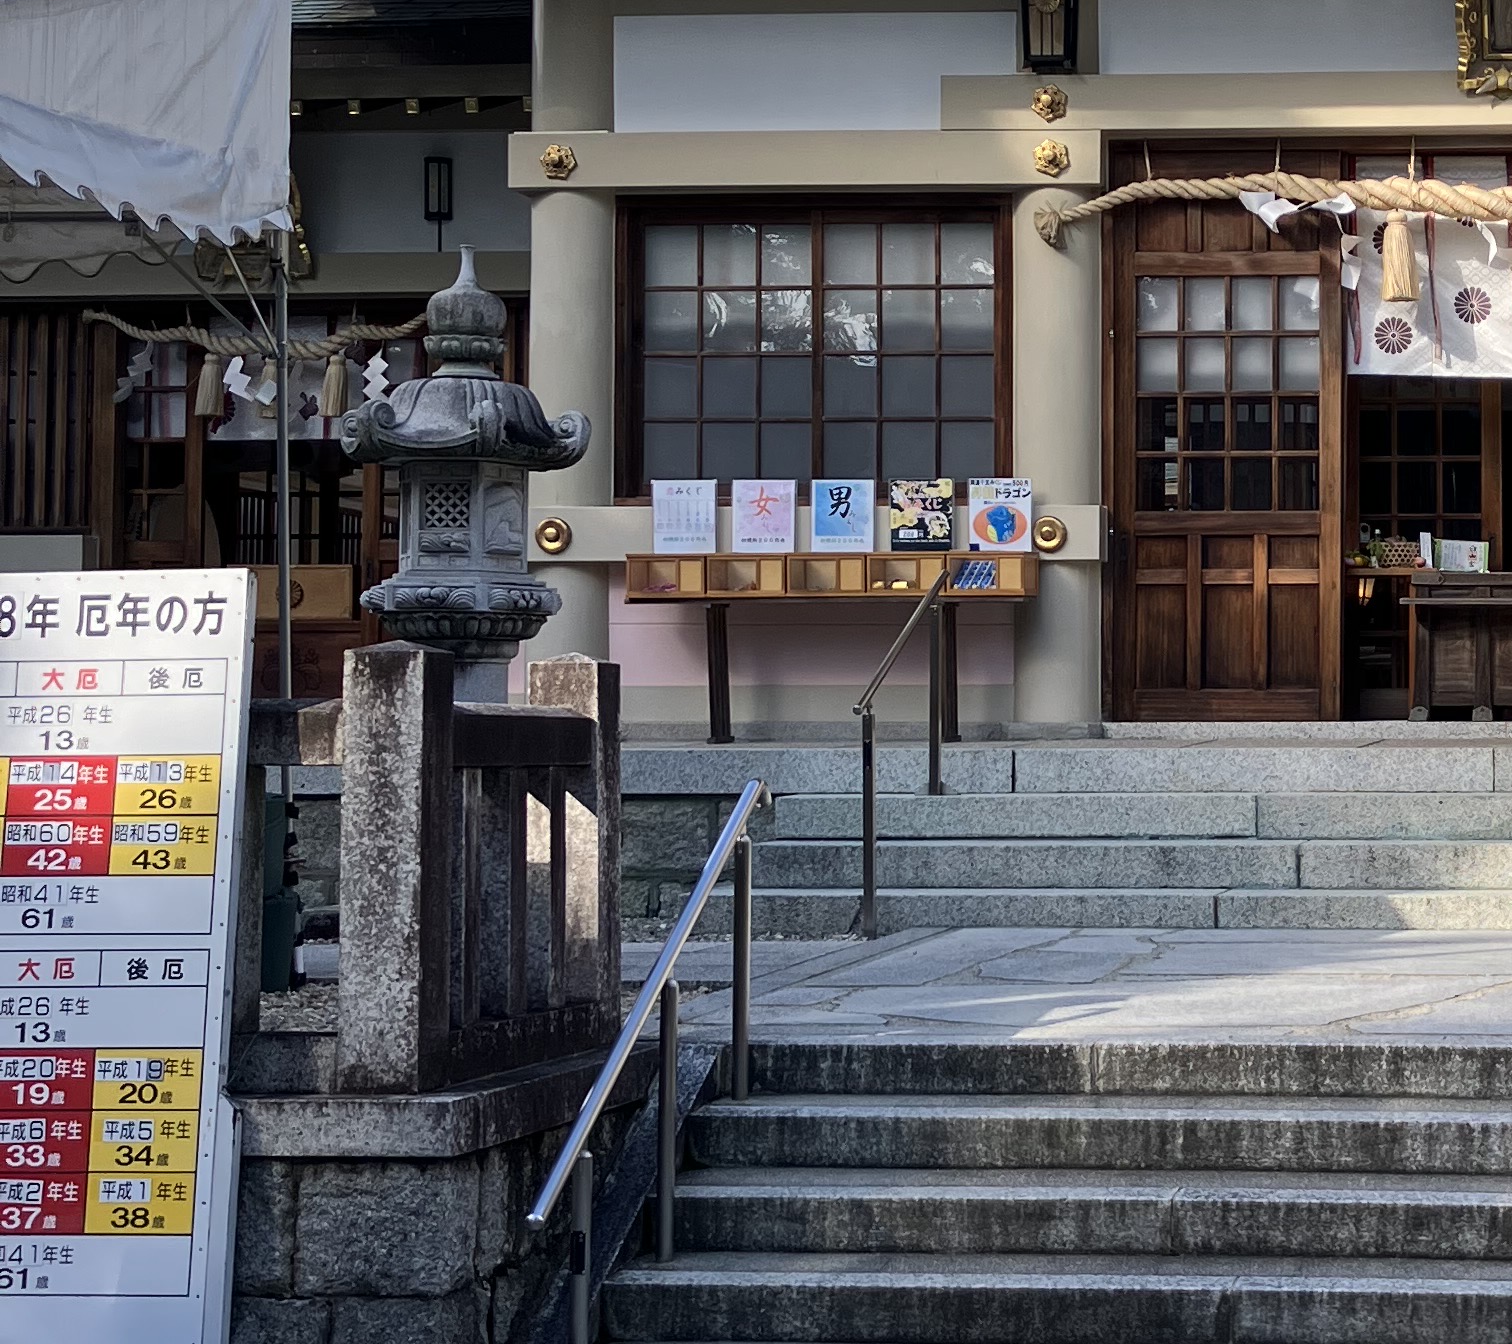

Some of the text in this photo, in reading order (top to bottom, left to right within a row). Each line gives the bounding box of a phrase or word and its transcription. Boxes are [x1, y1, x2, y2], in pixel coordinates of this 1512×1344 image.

[750, 485, 779, 516] 女
[828, 486, 853, 518] 男
[75, 591, 228, 637] 厄年の方
[39, 730, 90, 751] 13歳
[11, 763, 109, 784] 平成14年生
[119, 763, 212, 783] 平成13年生
[33, 789, 88, 811] 25歳
[139, 789, 193, 809] 26歳
[6, 823, 105, 845] 昭和60年生
[114, 823, 210, 844] 昭和59年生
[27, 848, 82, 871] 42歳
[132, 849, 187, 870] 43歳
[1, 884, 100, 904] 昭和41年生
[21, 908, 74, 929] 61歳
[15, 1022, 66, 1043] 13歳
[97, 1058, 195, 1079] 平成19年生
[11, 1082, 65, 1105] 19歳
[118, 1083, 173, 1104] 20歳
[5, 1144, 61, 1167] 33歳
[114, 1145, 169, 1167] 34歳
[1, 1207, 57, 1229] 37歳
[110, 1207, 165, 1229] 38歳
[0, 1245, 74, 1265] 41年生
